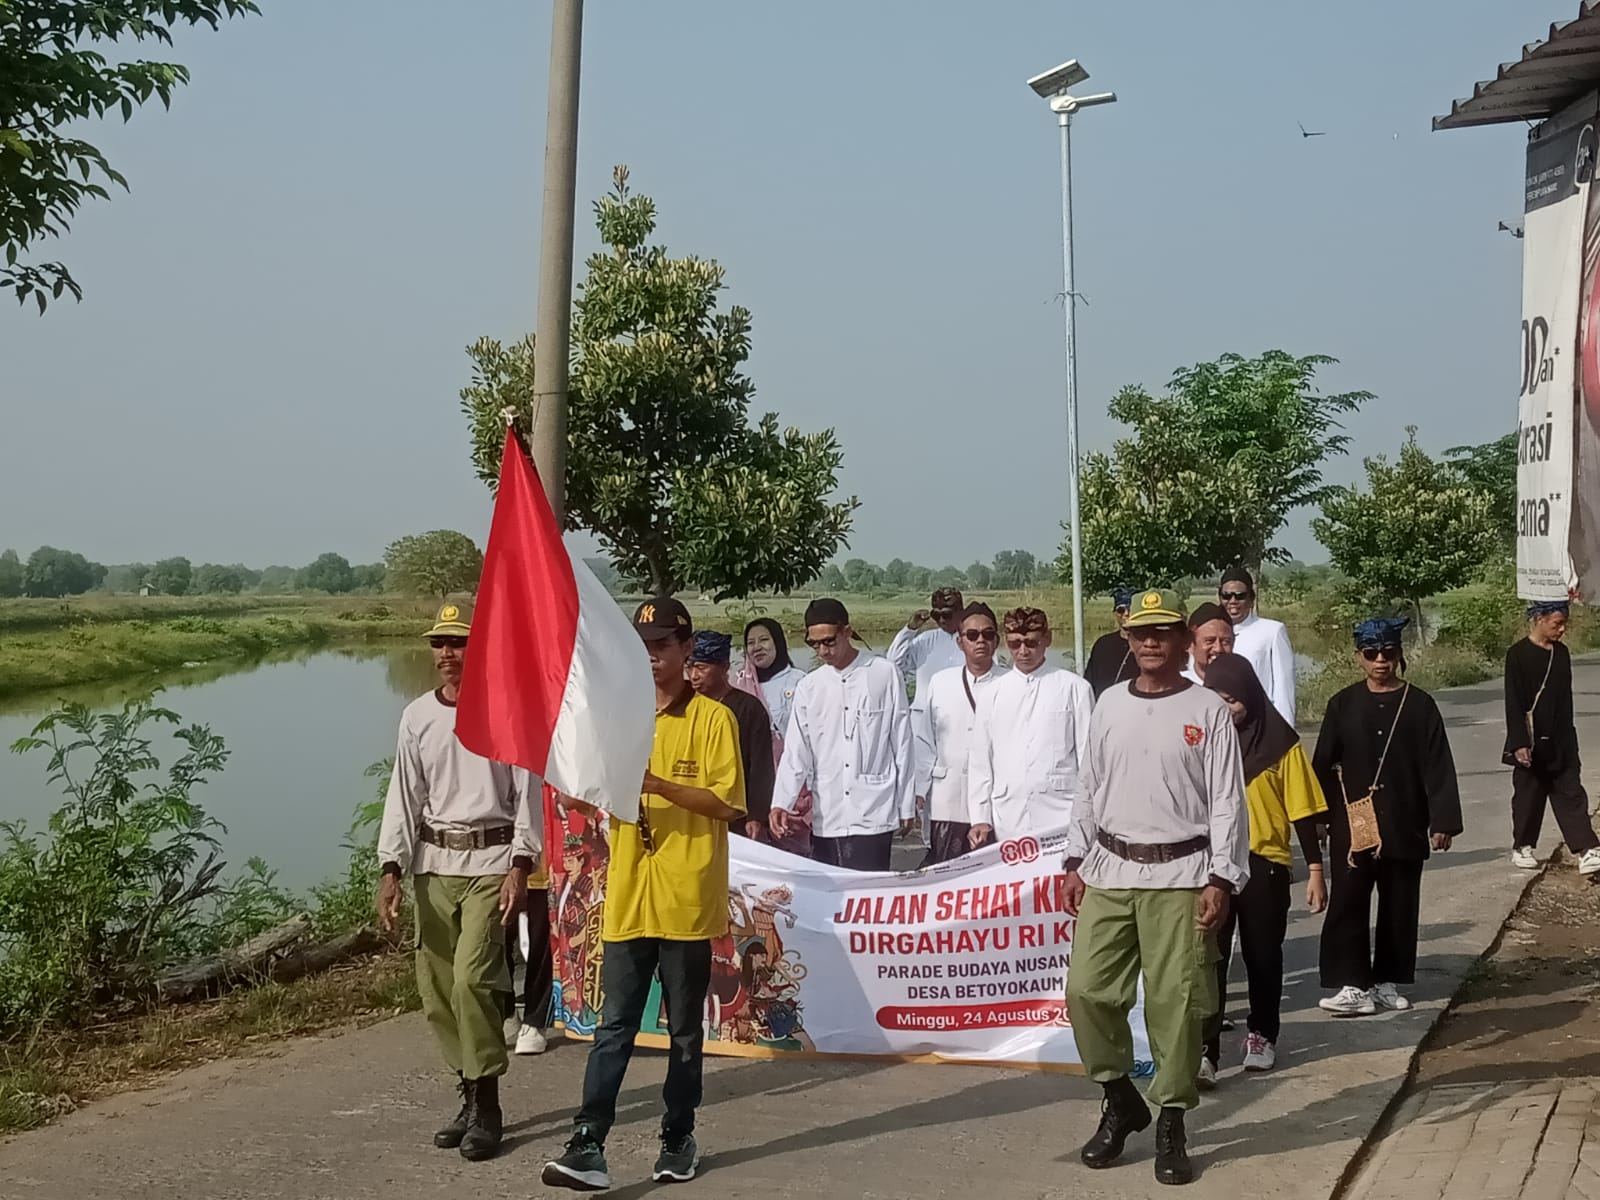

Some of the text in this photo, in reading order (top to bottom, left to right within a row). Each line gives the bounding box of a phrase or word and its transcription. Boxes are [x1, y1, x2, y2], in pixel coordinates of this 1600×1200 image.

[1000, 836, 1039, 866] 80
[834, 893, 928, 925] JALAN
[935, 880, 1025, 921] SEHAT
[850, 919, 1077, 955] DIRGAHAYU RI K
[877, 965, 943, 979] PARADE
[948, 961, 1010, 978] BUDAYA
[907, 976, 1064, 999] DESA BETOYOKAUM
[896, 1012, 960, 1029] Minggu,
[963, 1012, 983, 1025] 24
[986, 1008, 1050, 1025] Agustus
